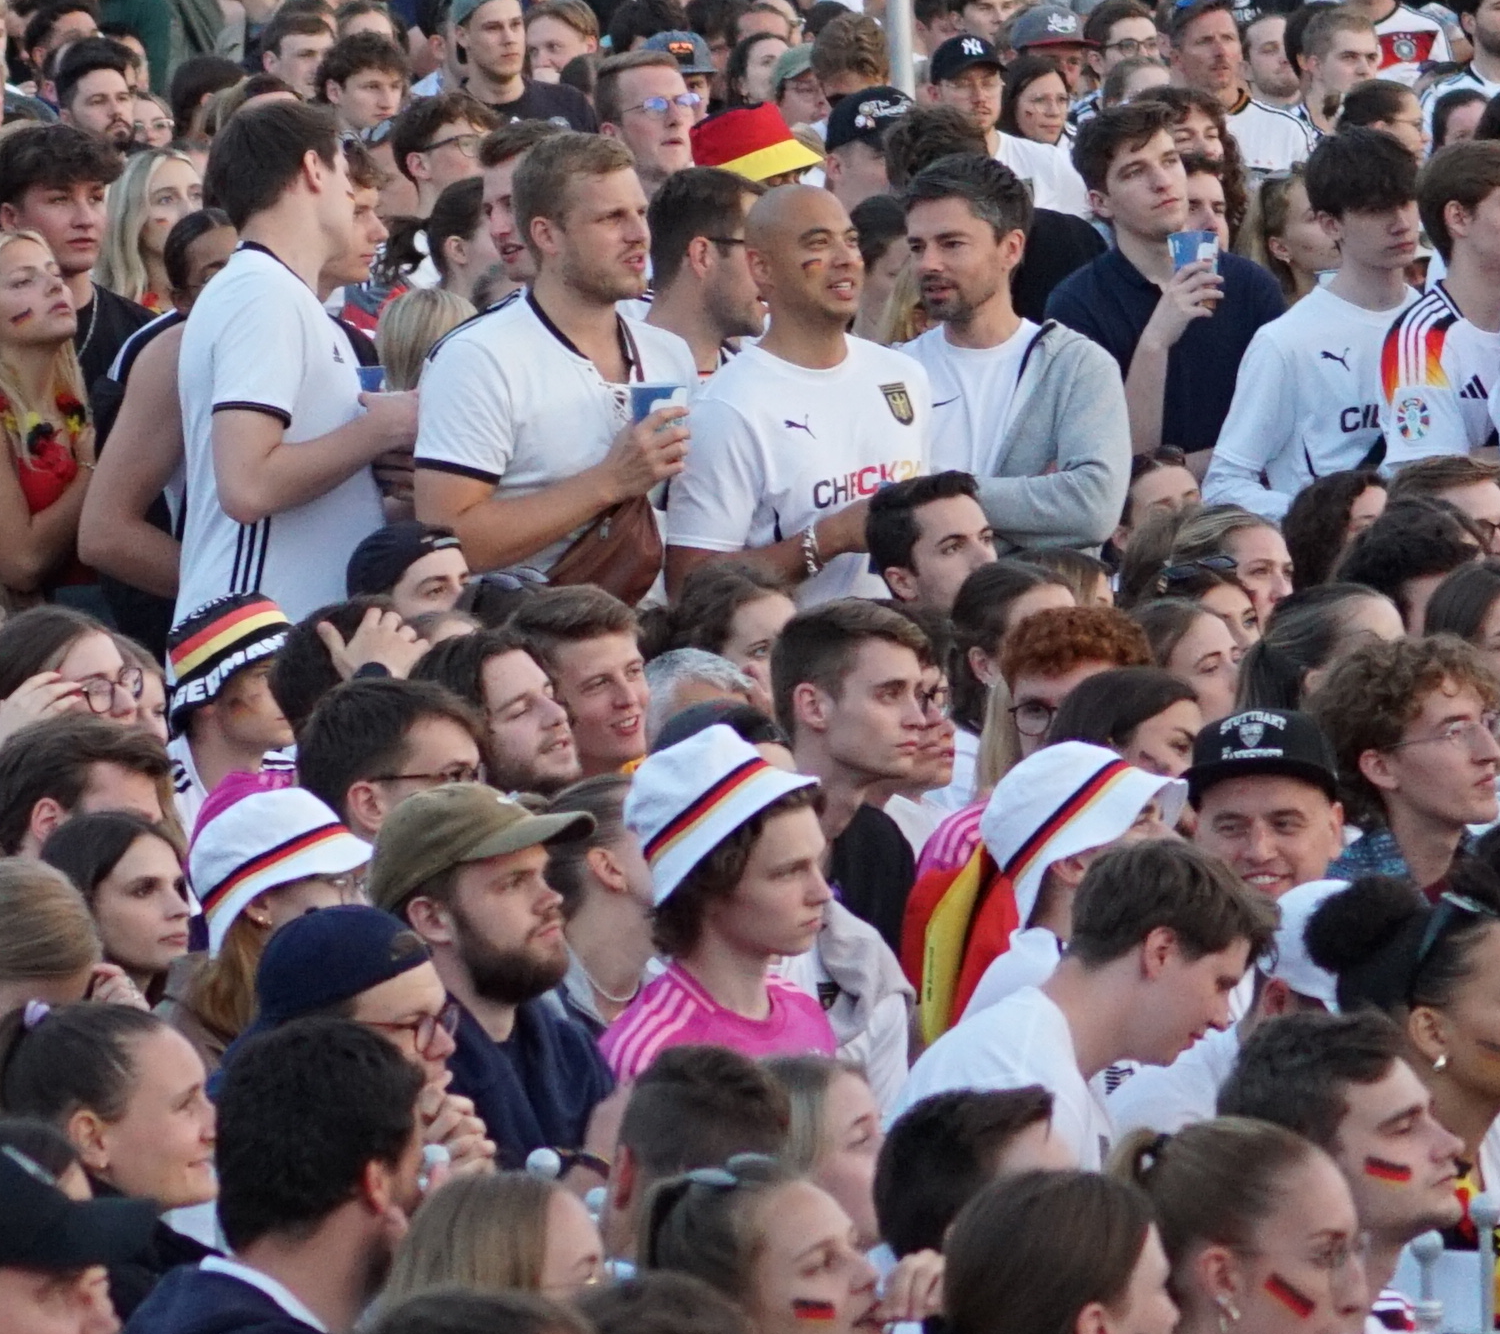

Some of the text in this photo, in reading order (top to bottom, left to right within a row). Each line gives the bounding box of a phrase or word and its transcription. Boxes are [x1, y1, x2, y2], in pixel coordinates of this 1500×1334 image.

[961, 38, 984, 55] NY
[813, 460, 922, 509] CHECK2
[1219, 710, 1287, 735] STUTTGART
